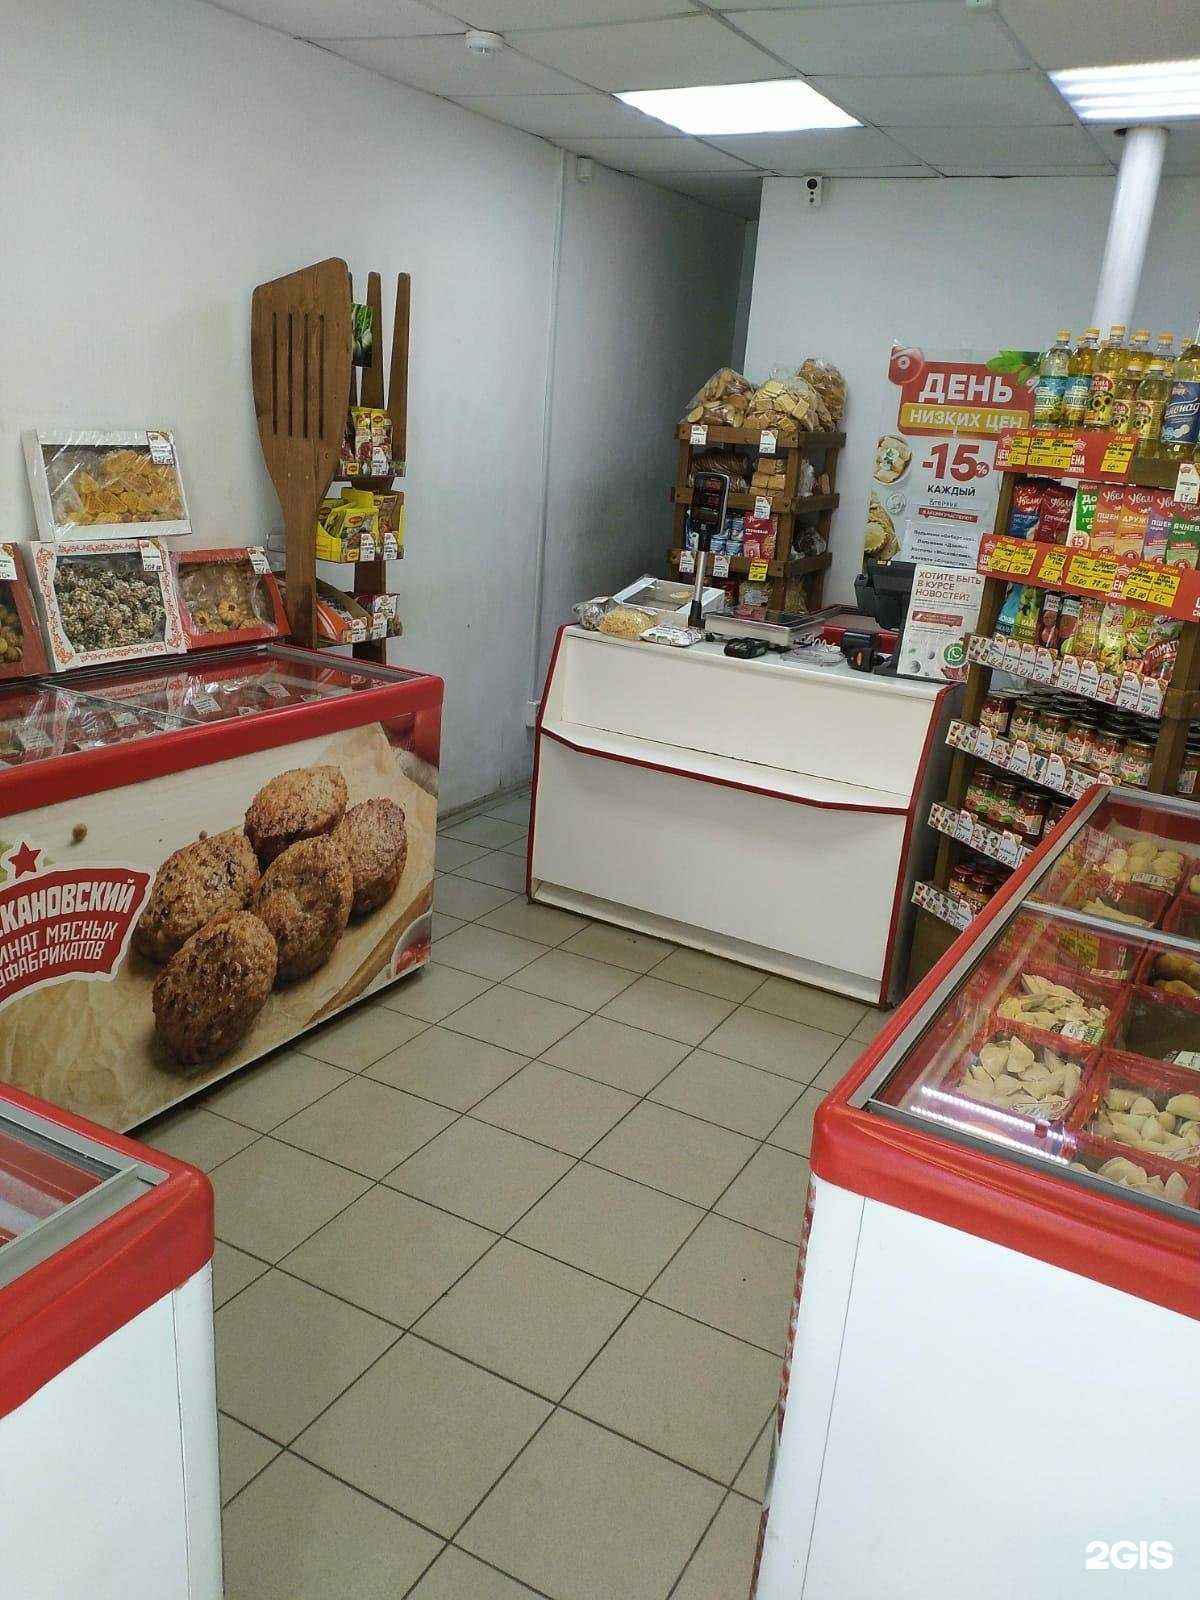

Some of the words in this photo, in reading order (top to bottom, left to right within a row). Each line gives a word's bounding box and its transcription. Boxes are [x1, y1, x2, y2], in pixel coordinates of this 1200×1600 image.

[918, 372, 1013, 404] ДЕНЬ
[909, 408, 981, 428] НИЗКИХ
[927, 484, 977, 497] КАЖДЫЙ
[919, 571, 955, 583] ХОТИТЕ
[925, 581, 955, 591] КУРСЕ
[0, 878, 136, 936] КАНОВСКИЙ
[46, 920, 119, 946] МЯСНЫХ
